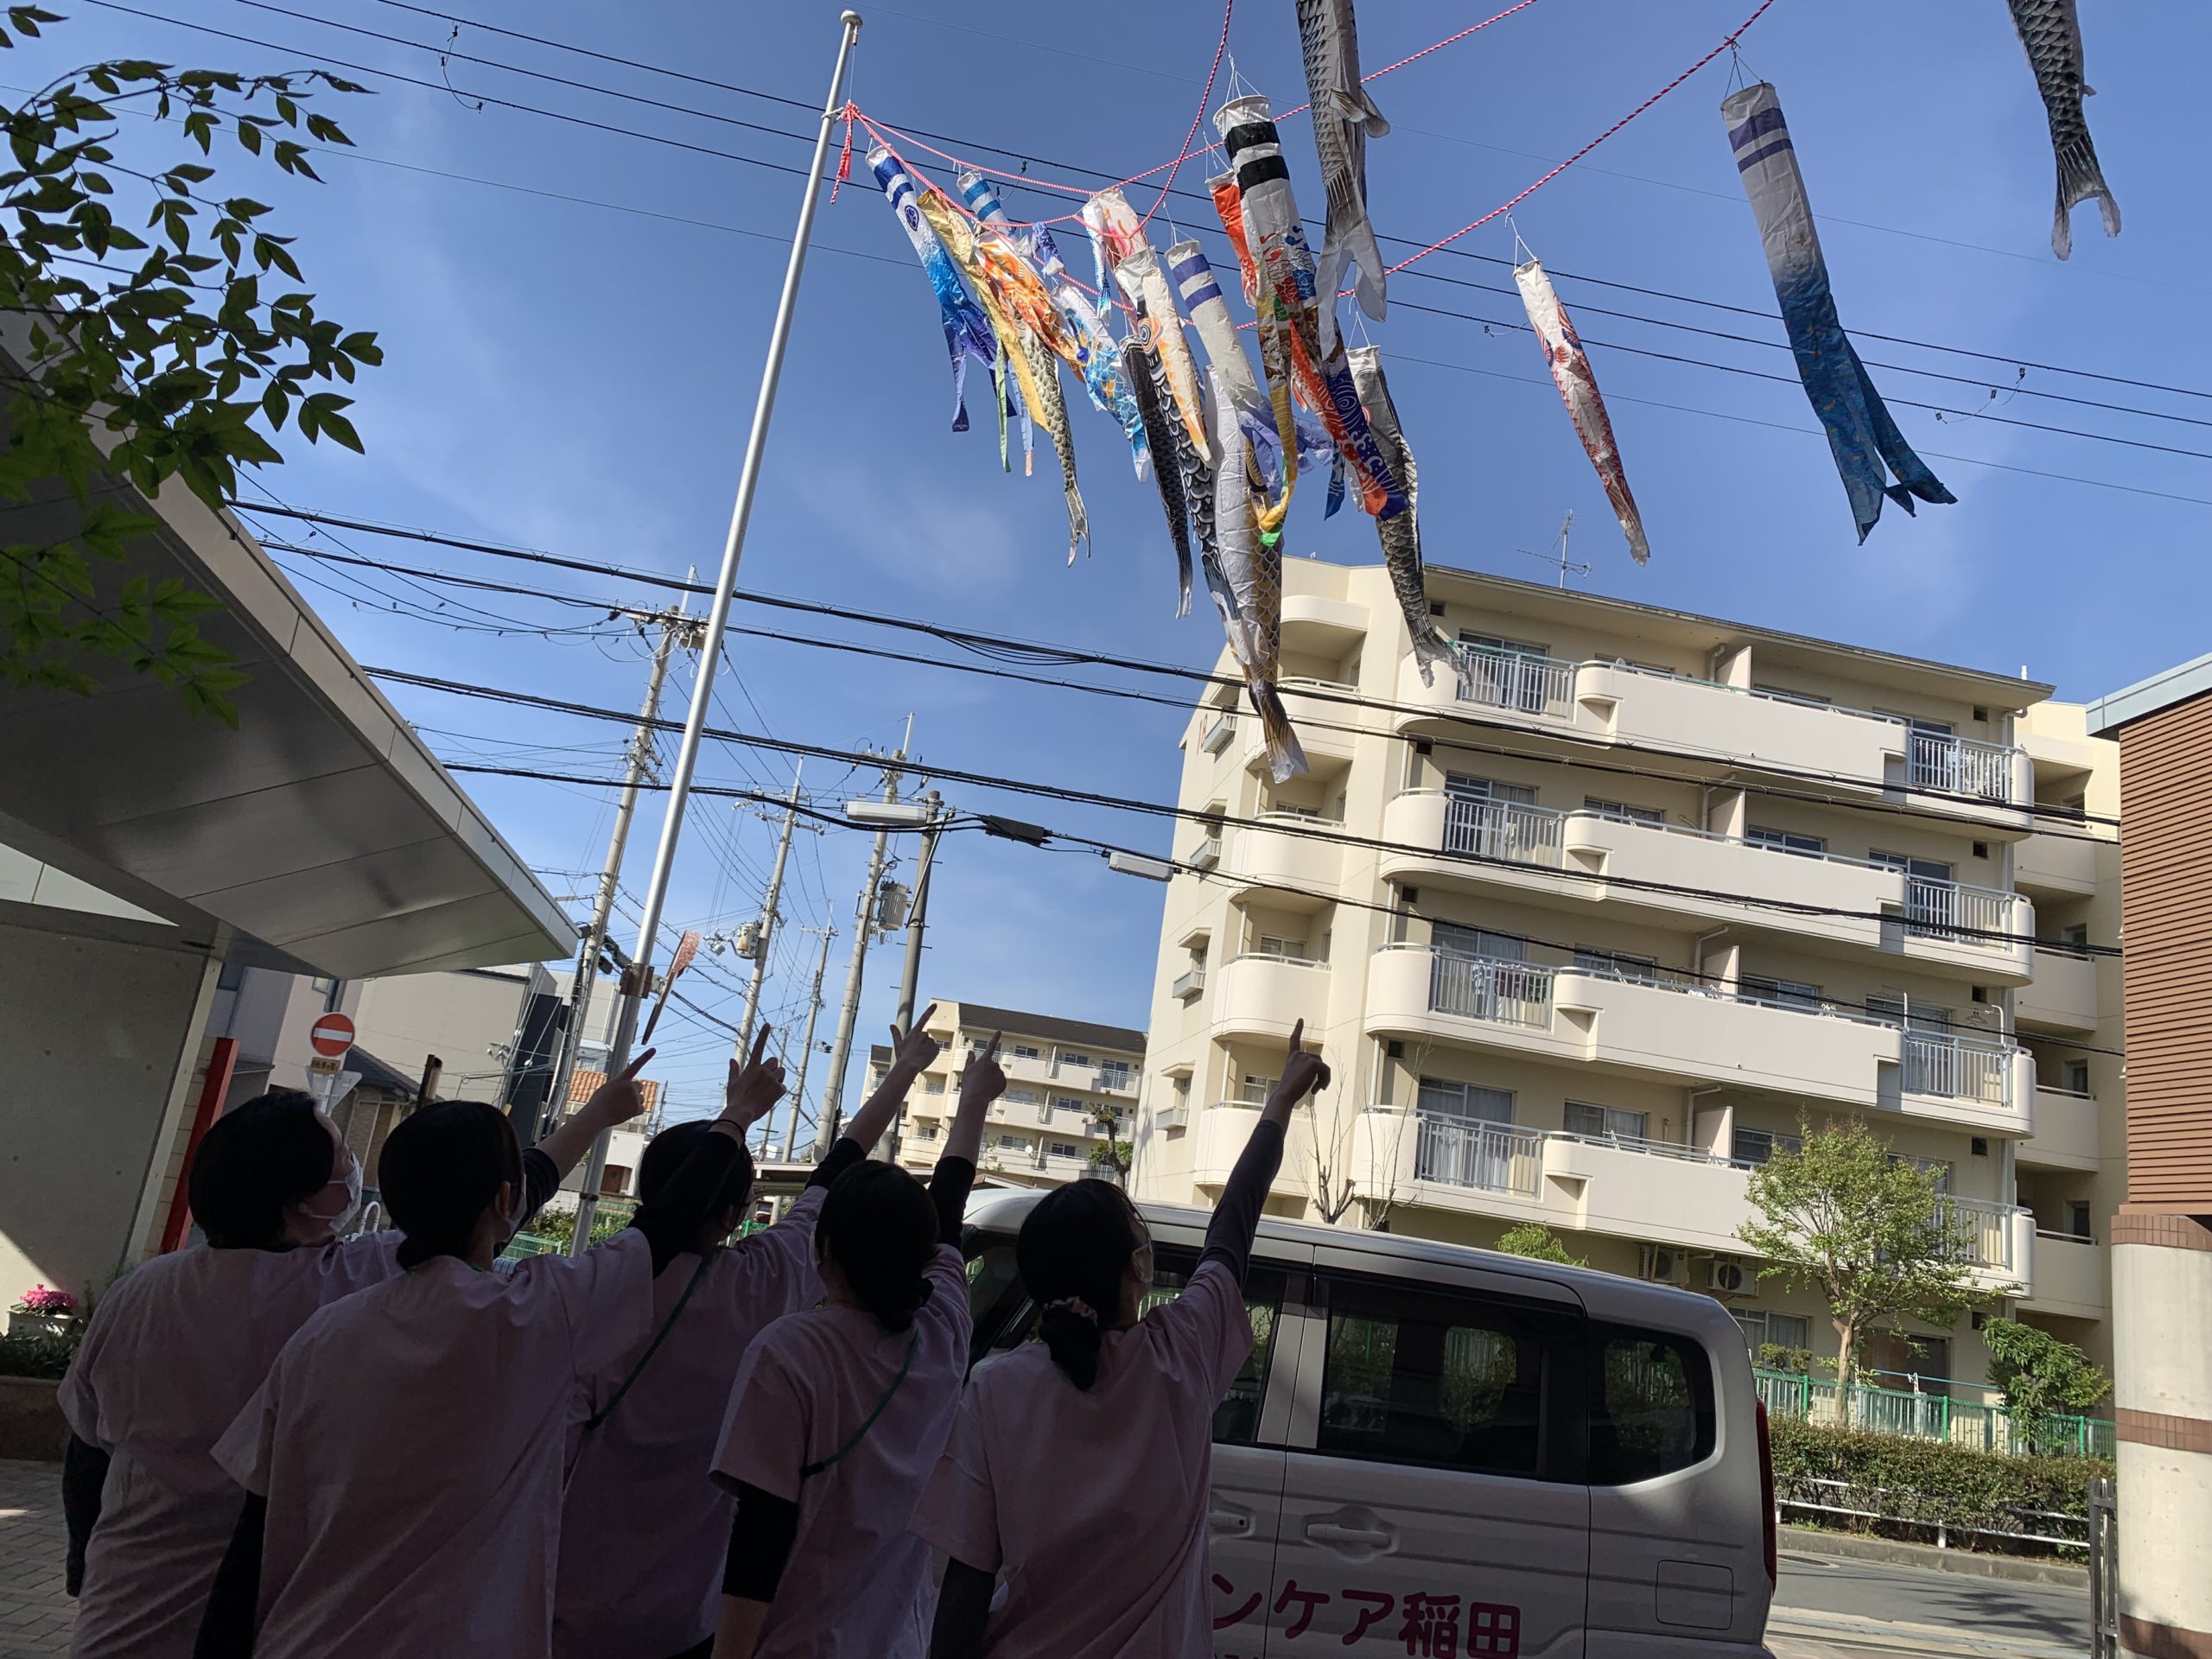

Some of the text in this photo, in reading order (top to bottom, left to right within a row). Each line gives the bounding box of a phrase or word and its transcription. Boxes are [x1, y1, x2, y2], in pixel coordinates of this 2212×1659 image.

[1211, 1573, 1521, 1659] ンケア稲田
